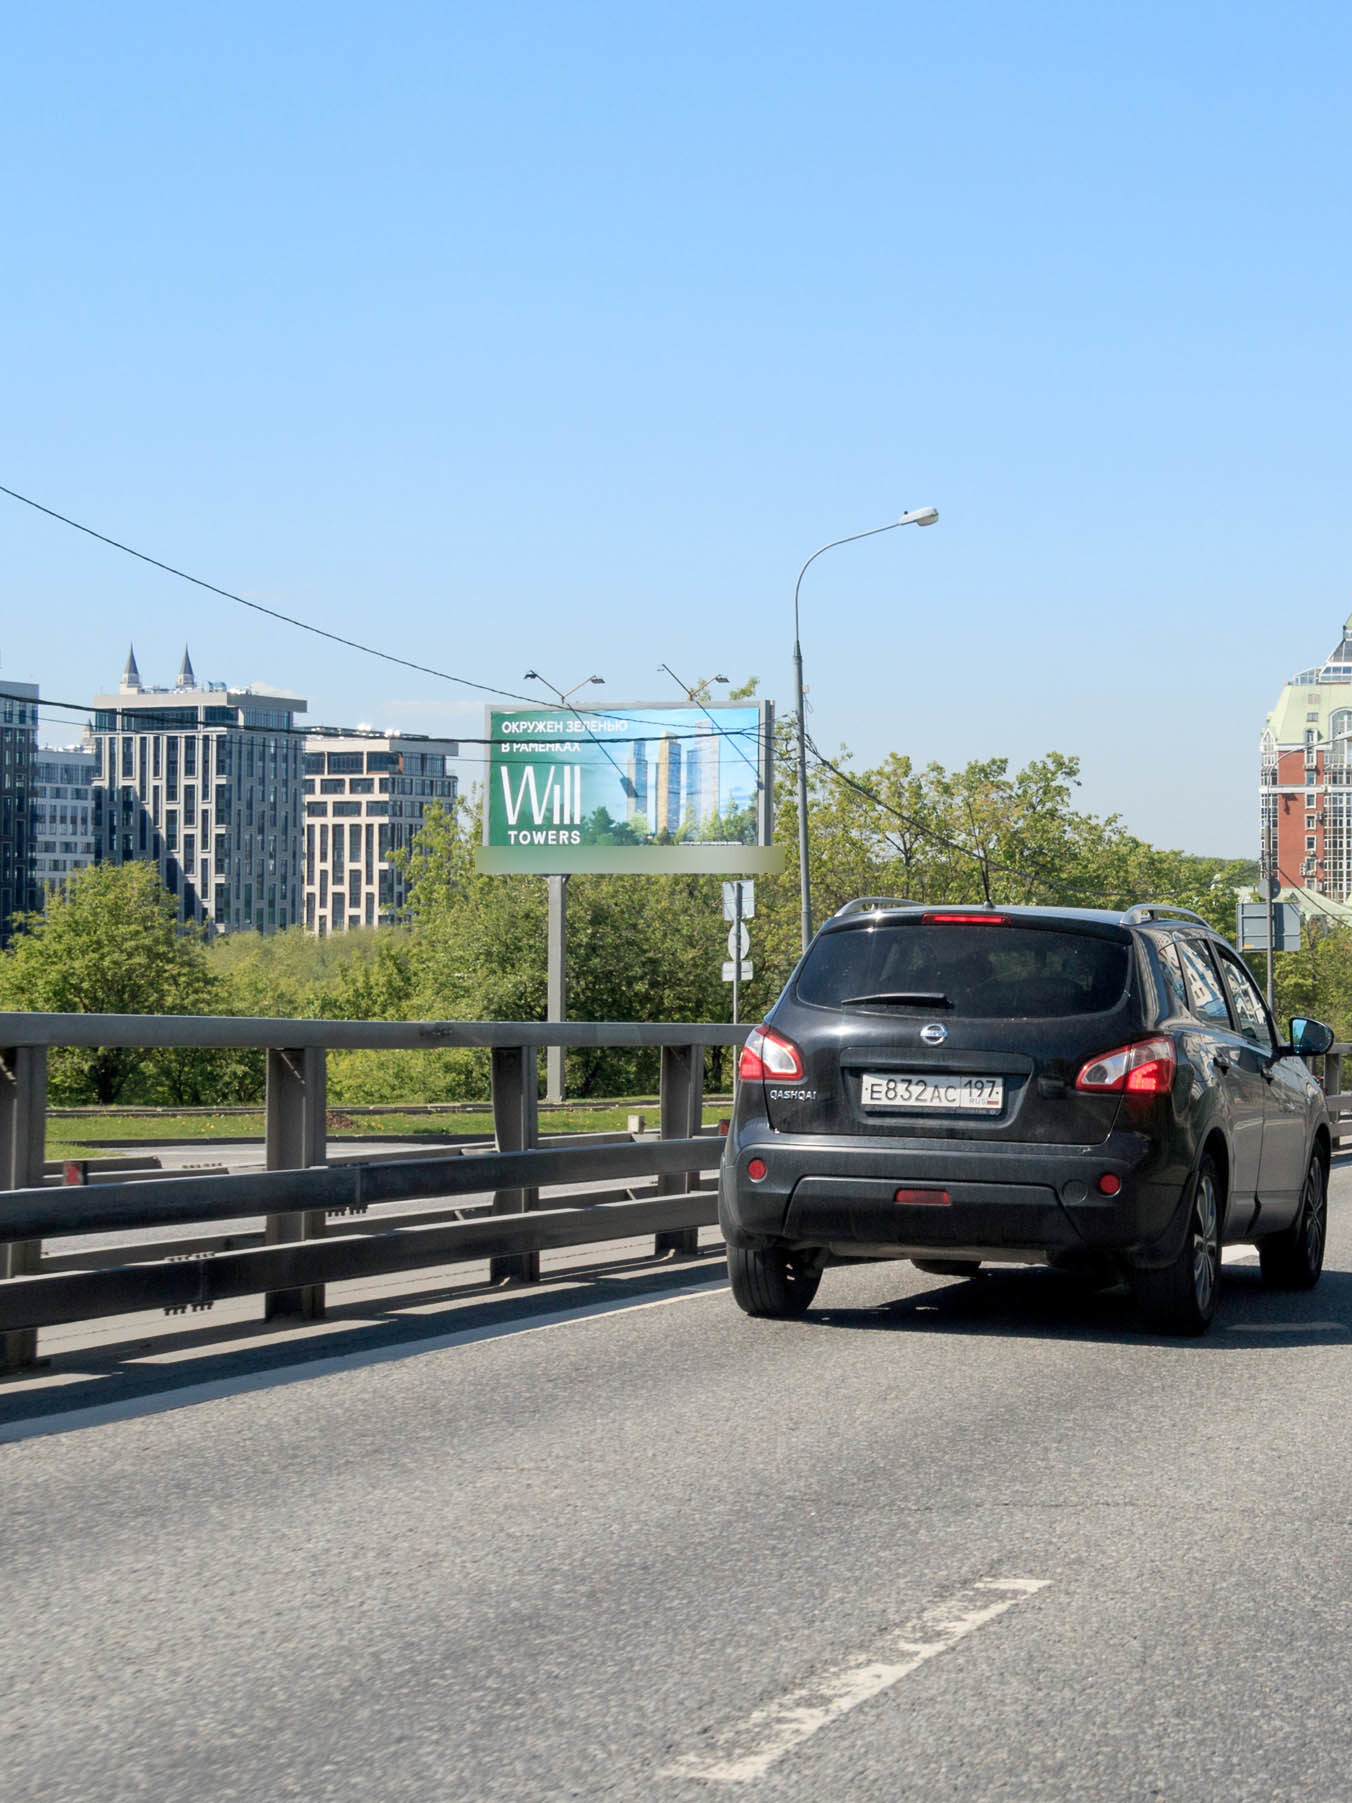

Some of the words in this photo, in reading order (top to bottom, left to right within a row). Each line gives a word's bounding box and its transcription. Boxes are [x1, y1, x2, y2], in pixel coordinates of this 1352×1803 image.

[502, 721, 563, 734] ОКРУЖЕН
[566, 720, 628, 732] ЗЕЛЕНЬЮ
[500, 765, 580, 825] Will
[508, 830, 581, 845] TOWERS
[770, 1090, 816, 1101] QASHQAI
[964, 1079, 997, 1098] 197
